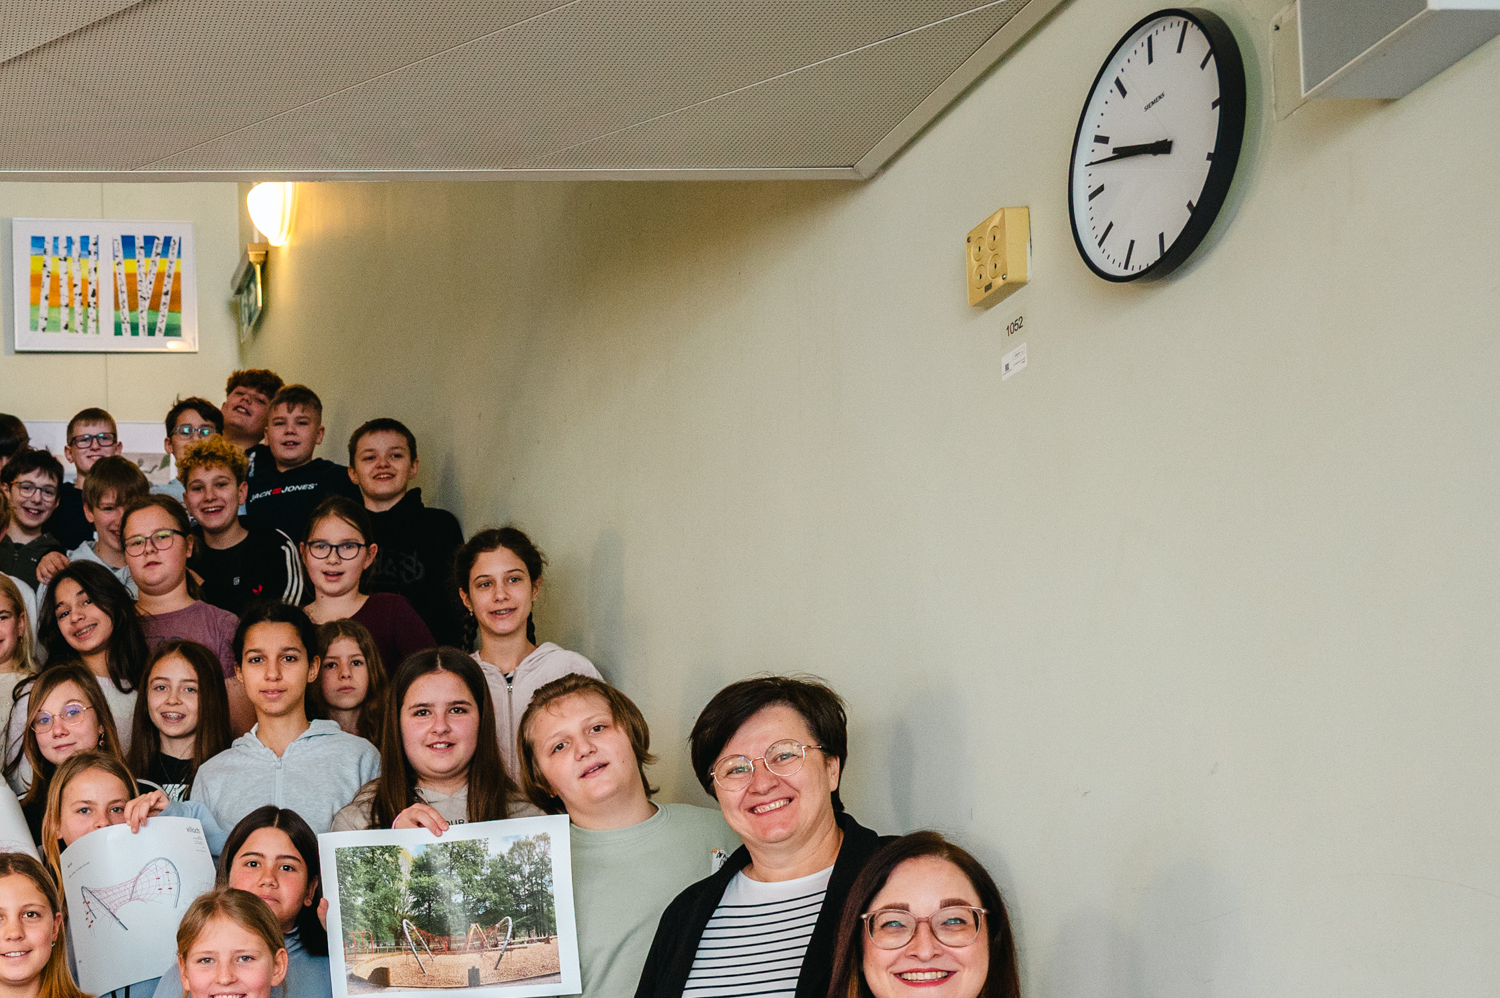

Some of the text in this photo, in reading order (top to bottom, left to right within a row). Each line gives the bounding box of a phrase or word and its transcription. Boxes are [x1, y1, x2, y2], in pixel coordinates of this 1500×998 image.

[1144, 91, 1165, 112] SIEMENS
[1006, 315, 1024, 337] 1052
[249, 483, 315, 503] JACK JONES
